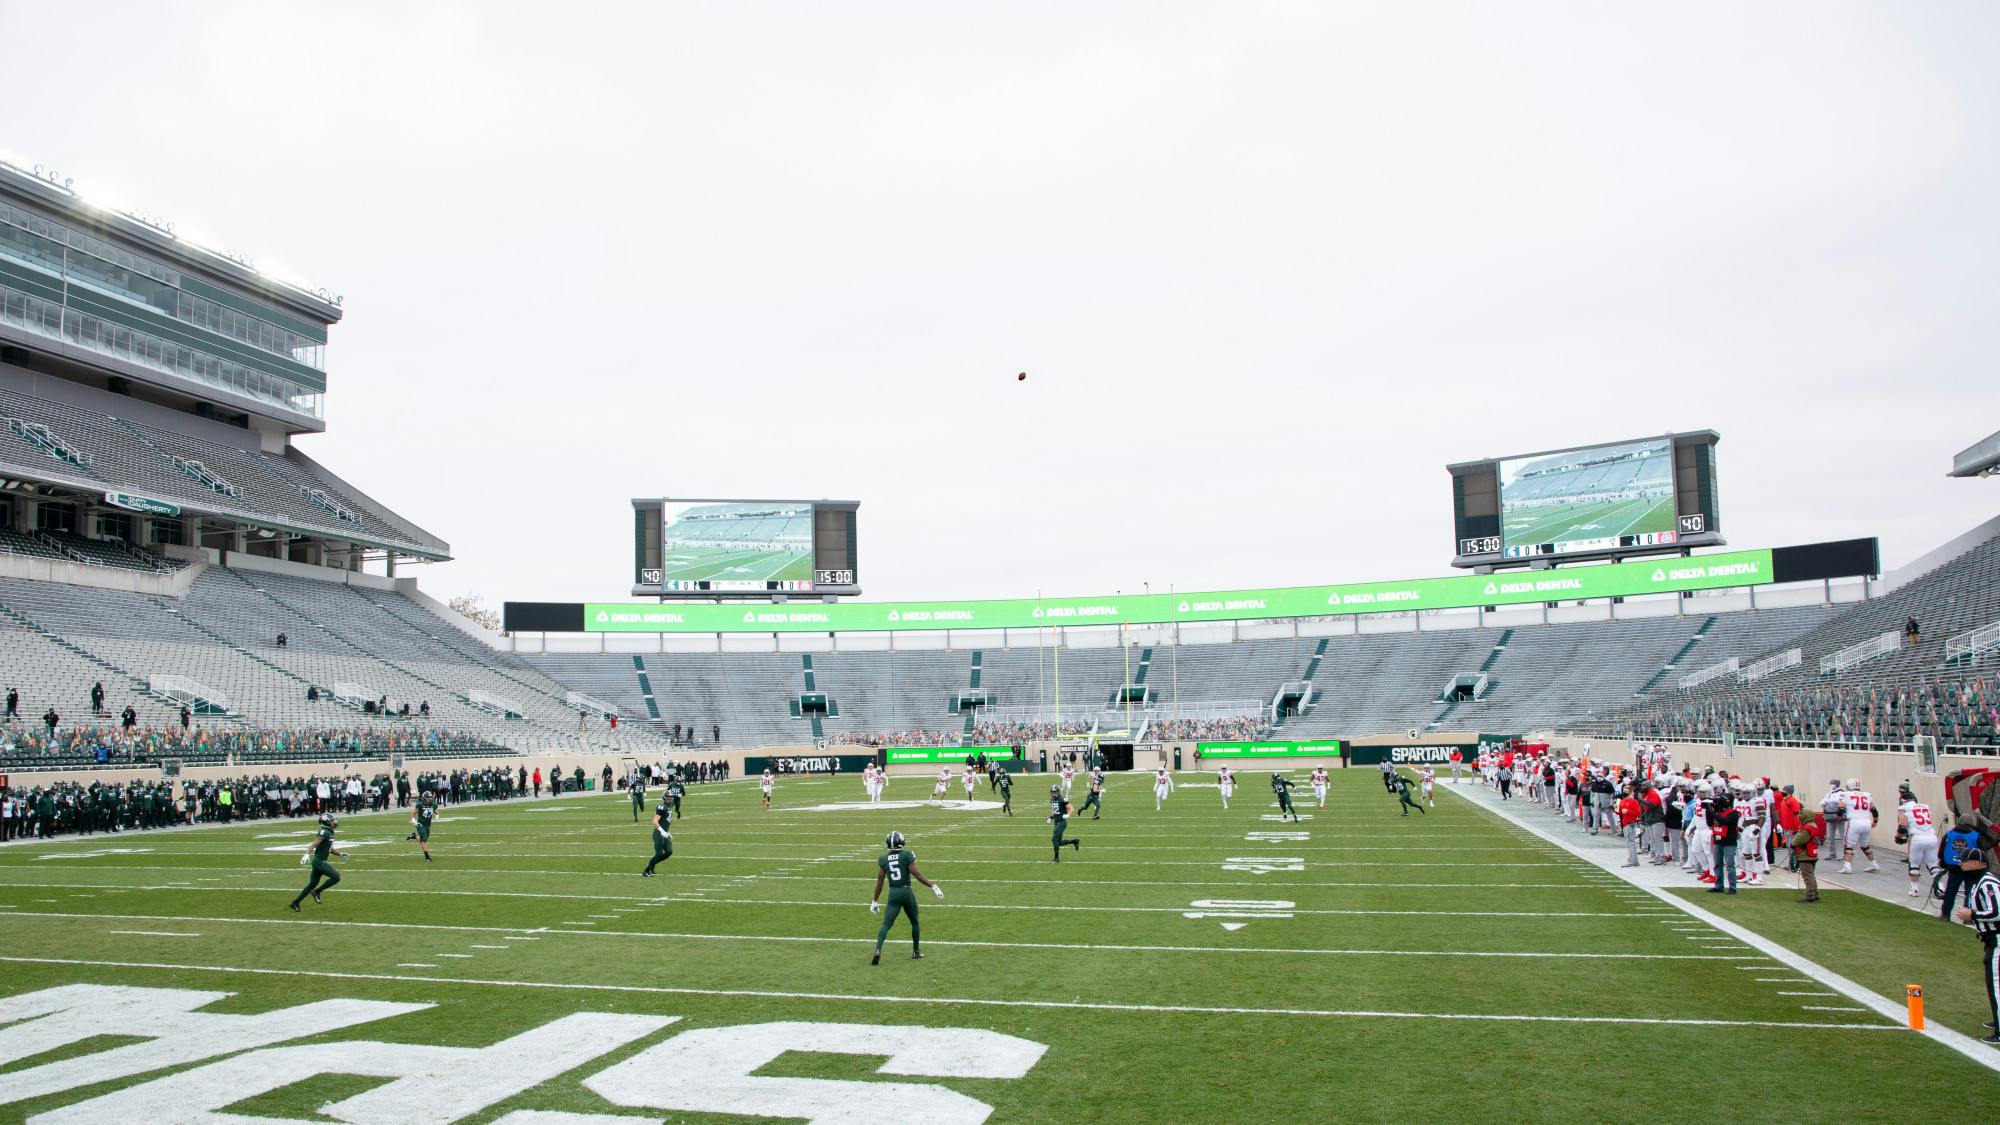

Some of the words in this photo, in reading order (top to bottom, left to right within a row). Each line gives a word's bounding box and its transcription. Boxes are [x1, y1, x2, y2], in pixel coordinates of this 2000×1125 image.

[129, 501, 172, 514] DAUGHERTY
[1681, 516, 1702, 531] 40
[1466, 538, 1500, 553] 15:00
[644, 570, 660, 581] 40
[819, 570, 851, 582] 15:00
[1669, 568, 1706, 581] DELTA
[1708, 562, 1759, 577] DENTAL
[1500, 581, 1535, 594] DELTA
[1536, 579, 1582, 592] DENTAL
[1343, 593, 1376, 604] DELTA
[1377, 590, 1420, 602] DENTAL
[1046, 607, 1077, 617] DELTA
[1078, 606, 1119, 616] DENTAL
[1192, 601, 1224, 612] DELTA
[1225, 600, 1266, 610] DENTAL
[611, 613, 641, 623] DELTA
[643, 613, 684, 623] DENTAL
[758, 613, 788, 623] DELTA
[789, 613, 829, 623] DENTAL
[902, 611, 932, 621] DELTA
[934, 610, 974, 621] DENTAL
[1850, 796, 1869, 811] 76
[1912, 809, 1932, 826] 53
[888, 860, 902, 881] 5
